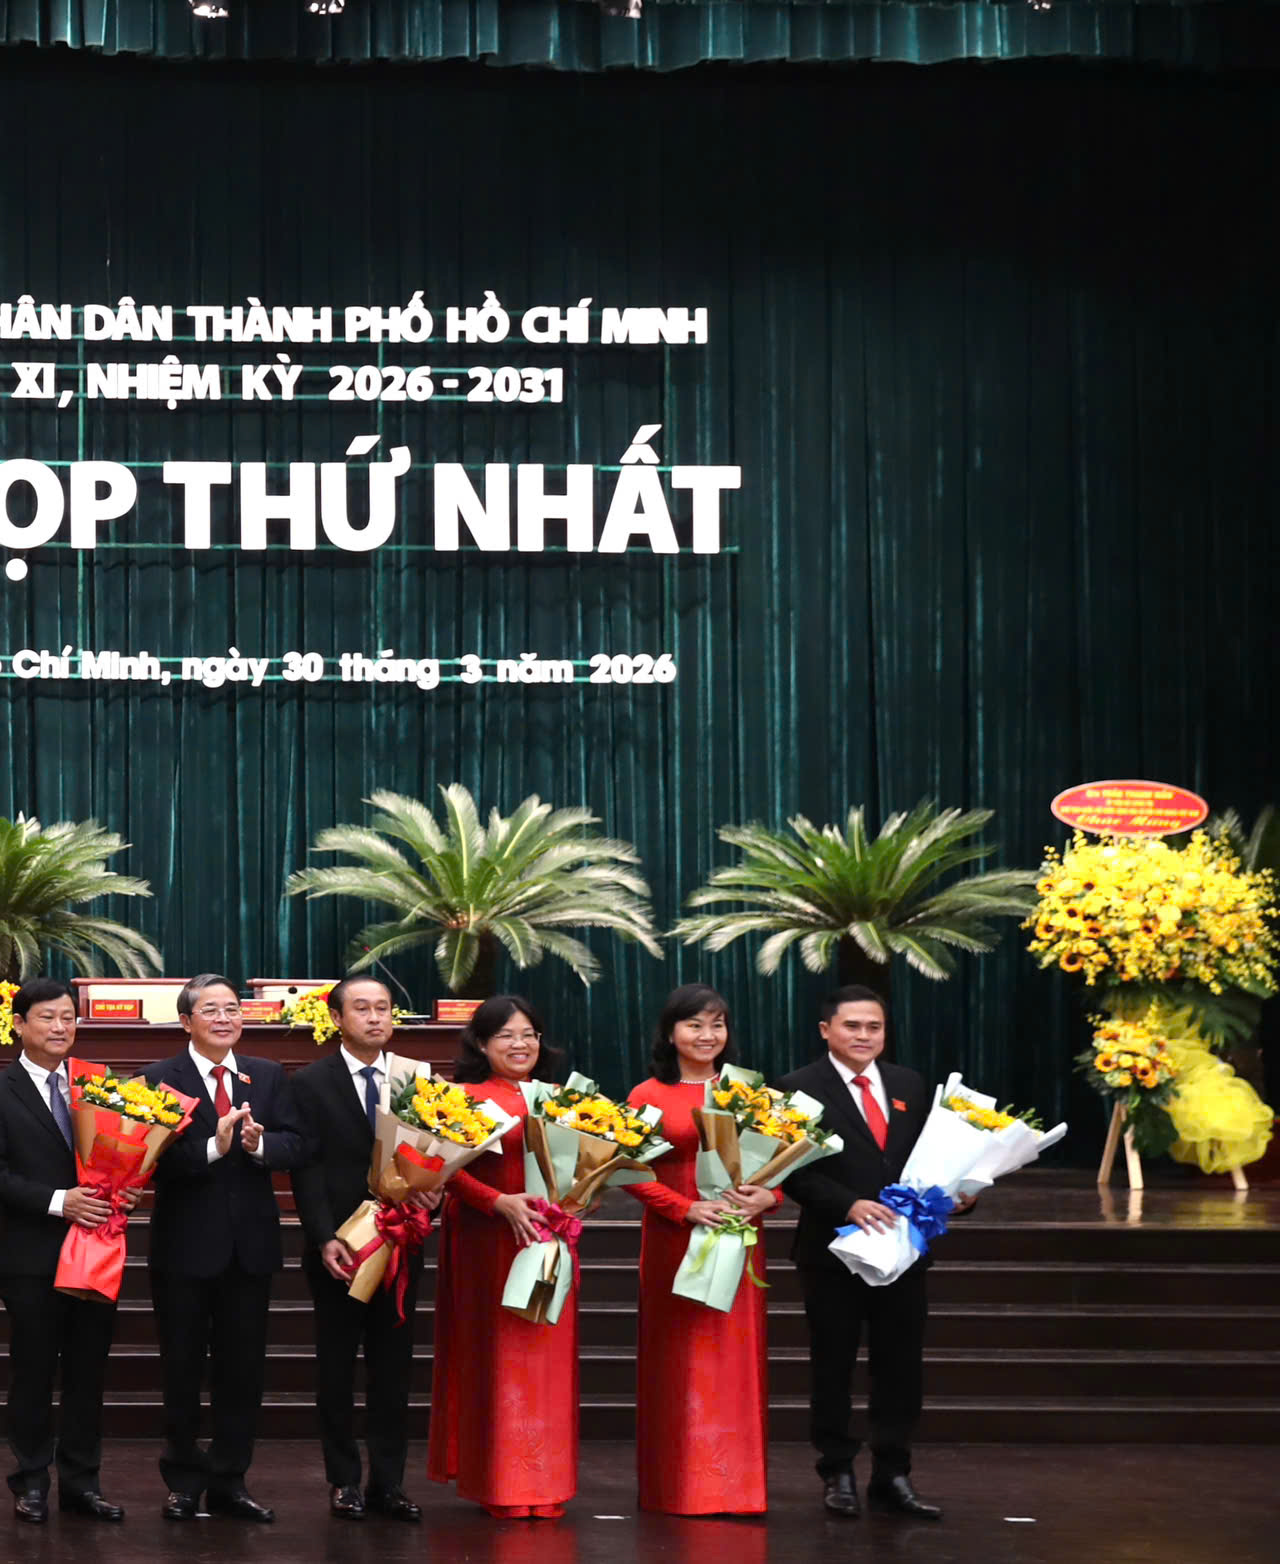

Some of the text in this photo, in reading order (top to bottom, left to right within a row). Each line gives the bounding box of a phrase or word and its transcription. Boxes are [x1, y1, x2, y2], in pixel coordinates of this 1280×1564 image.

[83, 296, 174, 342] DÂN
[186, 296, 333, 343] THÀNH
[344, 290, 434, 343] PHỐ
[446, 290, 510, 344] HỒ
[521, 297, 593, 344] CHÍ
[600, 307, 708, 345] MINH
[10, 361, 74, 408] XI,
[86, 354, 222, 410] NHIỆM
[241, 353, 304, 401] KỲ
[327, 364, 434, 402] 2026
[464, 366, 564, 403] 2031
[162, 434, 412, 552] THỨ
[433, 423, 742, 555] NHẤT
[11, 645, 73, 681] Chí
[80, 650, 173, 686] Minh,
[181, 646, 273, 688] ngày
[281, 651, 325, 683] 30
[338, 648, 441, 691] tháng
[459, 653, 483, 684] 3
[496, 652, 575, 684] năm
[588, 653, 678, 684] 2026
